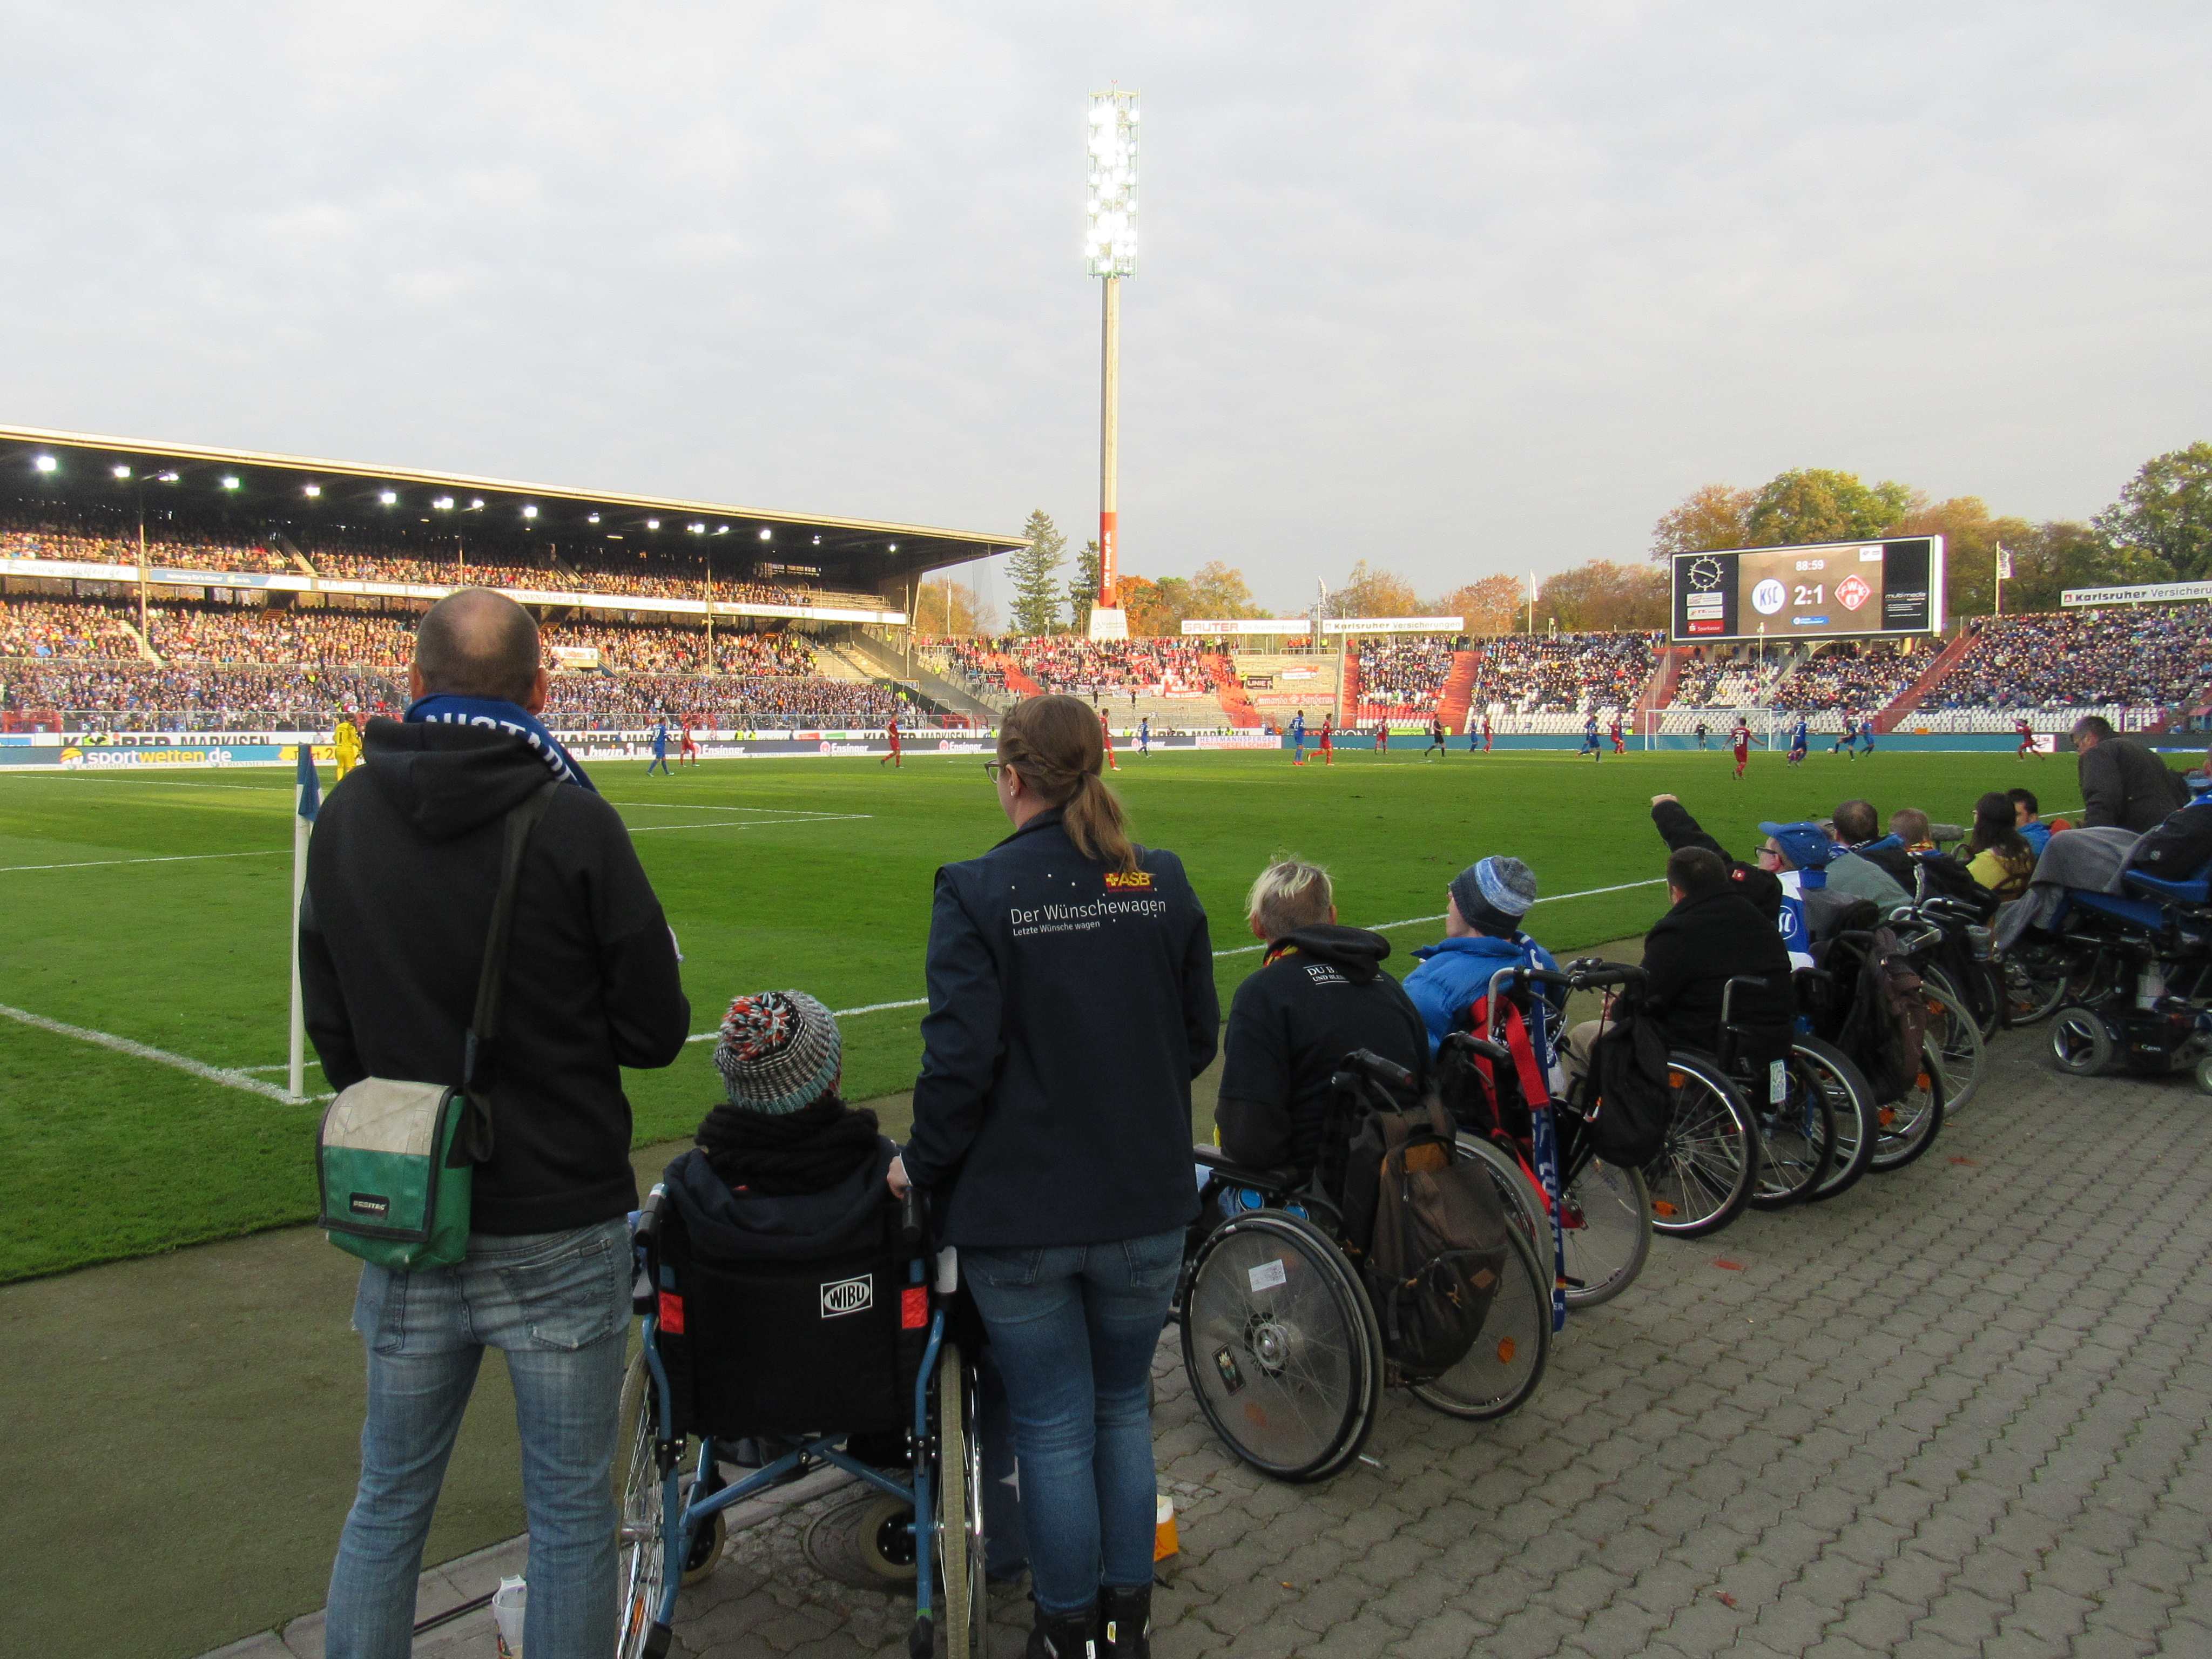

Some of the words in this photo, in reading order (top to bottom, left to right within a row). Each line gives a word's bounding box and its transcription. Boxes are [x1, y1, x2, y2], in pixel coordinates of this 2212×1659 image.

[1795, 559, 1825, 571] 88:59
[1759, 586, 1778, 606] KSC
[1793, 584, 1824, 605] 2:1
[2075, 590, 2148, 602] Karlsruher
[1184, 623, 1238, 632] SAUTER
[1334, 622, 1390, 630] Karlsruher
[1393, 621, 1460, 630] Versicherungen
[1734, 734, 1744, 744] 31
[702, 745, 745, 756] Ensinger
[832, 743, 868, 752] Ensinger
[949, 741, 982, 750] Ensinger
[87, 747, 232, 764] sportwetten.de
[1117, 872, 1150, 886] ASB
[1010, 908, 1040, 924] Der
[1043, 899, 1166, 920] Wünschewagen
[1013, 927, 1038, 936] Letzte
[1040, 923, 1073, 933] Wünsche
[1075, 920, 1101, 931] wagen
[1306, 966, 1325, 976] DU
[829, 1285, 865, 1308] WIBU
